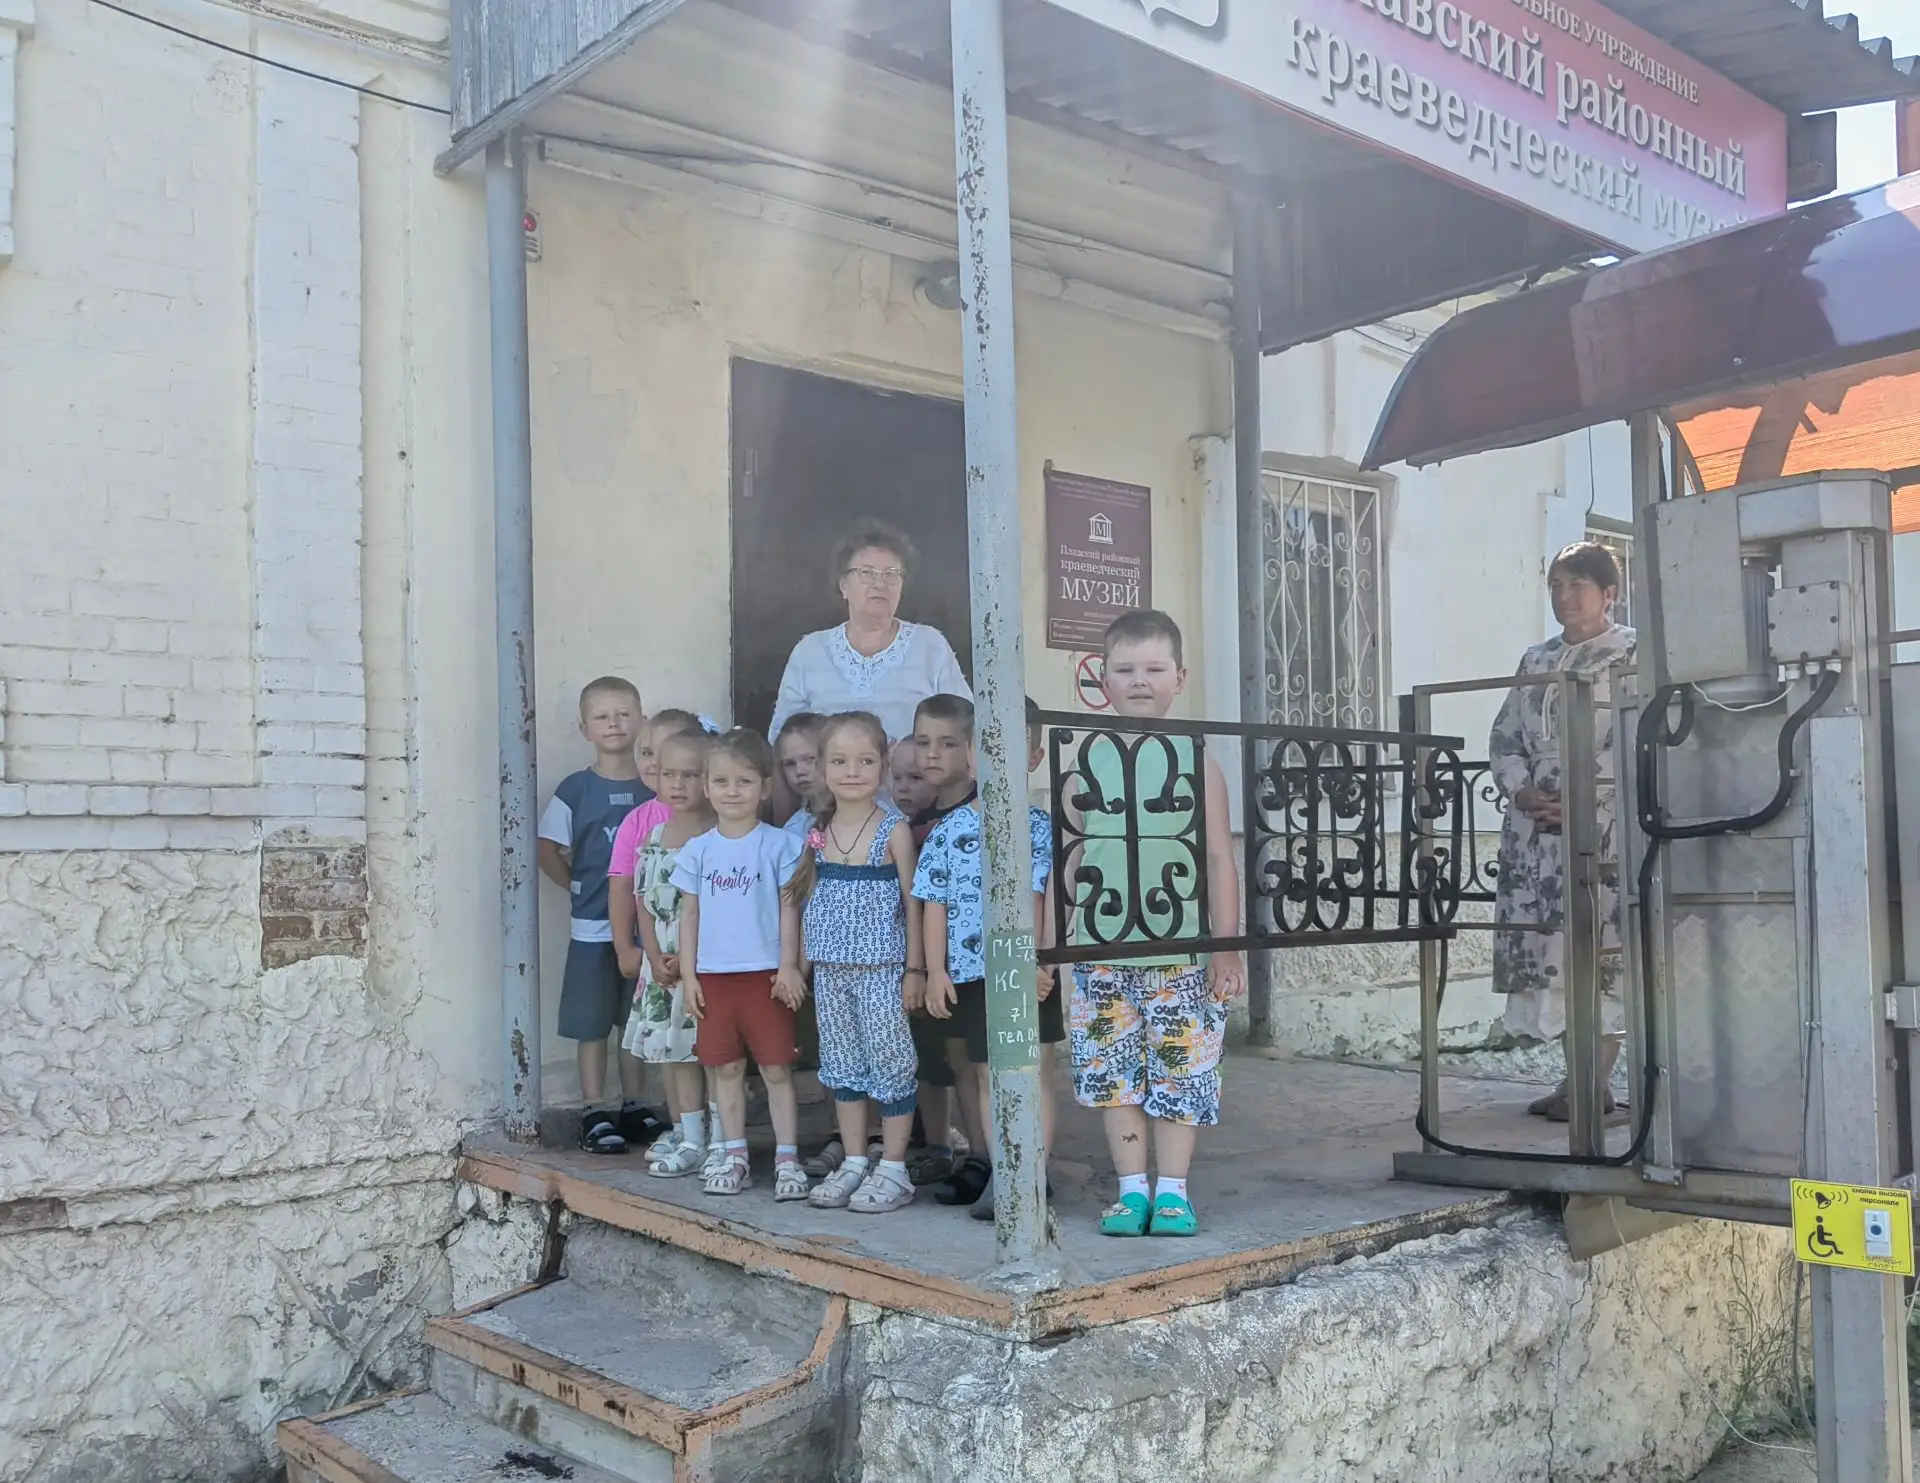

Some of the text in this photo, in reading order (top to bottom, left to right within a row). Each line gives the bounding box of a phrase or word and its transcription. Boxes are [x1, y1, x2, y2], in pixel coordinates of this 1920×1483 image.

[1584, 20, 1699, 104] УЧРЕЖДЕНИЕ
[1285, 14, 1748, 240] краеведческий муз
[1359, 0, 1746, 197] авский районный
[1060, 559, 1140, 579] краеведческий
[1060, 576, 1140, 608] МУЗЕЙ
[711, 864, 756, 896] family
